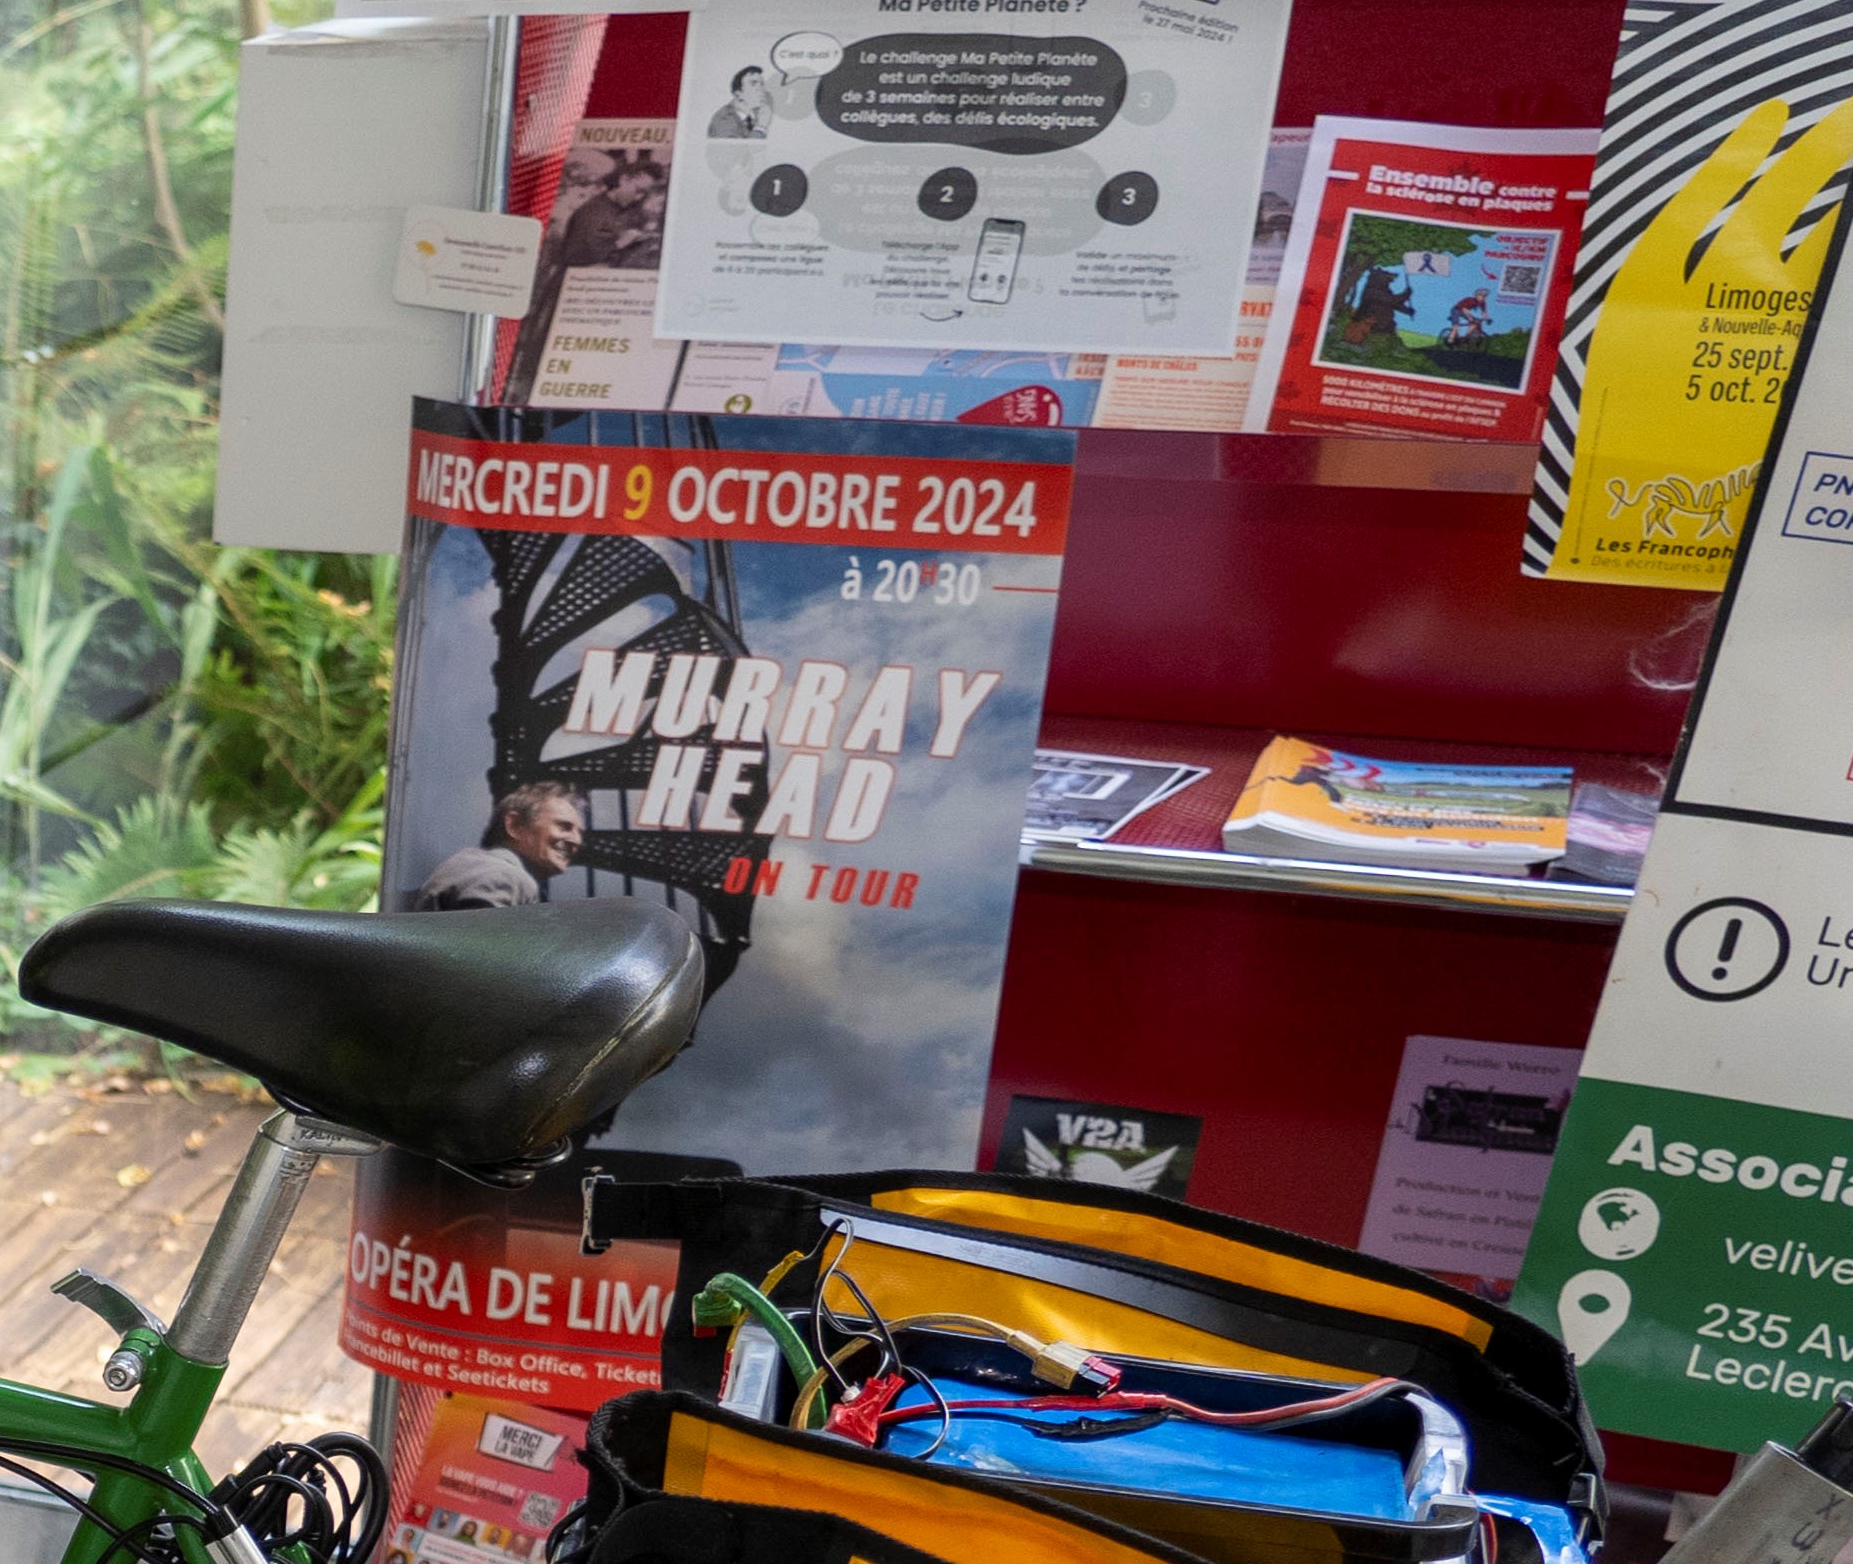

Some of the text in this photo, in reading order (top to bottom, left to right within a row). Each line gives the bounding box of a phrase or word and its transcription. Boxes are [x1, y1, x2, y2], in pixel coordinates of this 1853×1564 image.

[879, 51, 958, 69] challenge
[960, 52, 986, 65] Ma
[988, 52, 1033, 66] Petite
[930, 71, 1009, 89] challenge
[1011, 72, 1072, 90] ludique
[879, 92, 956, 105] semaines
[771, 179, 1137, 206] 1 2 3
[1366, 181, 1555, 213] la sclérose en plaques
[1369, 164, 1558, 199] Ensemble contre
[1705, 282, 1813, 316] Limoges
[552, 335, 631, 354] FEMMES
[1691, 341, 1790, 377] 25 sept.
[546, 358, 572, 375] EN
[539, 382, 612, 400] GUERRE
[1685, 374, 1756, 404] 5 oct.
[416, 447, 1038, 537] MERCREDI 9 OCTOBRE 2024
[1596, 537, 1632, 554] Les
[840, 556, 860, 600] à
[563, 647, 1001, 759] MURRAY
[635, 743, 896, 844] HEAD
[722, 855, 921, 911] ON TOUR
[1055, 1112, 1148, 1154] V2A
[349, 1231, 472, 1315] OPÉRA
[485, 1267, 554, 1326] DE
[1696, 1303, 1792, 1350] 235
[406, 1332, 589, 1380] Vente Box Office,
[422, 1359, 551, 1395] et Seetickets
[501, 1424, 544, 1448] MERCI
